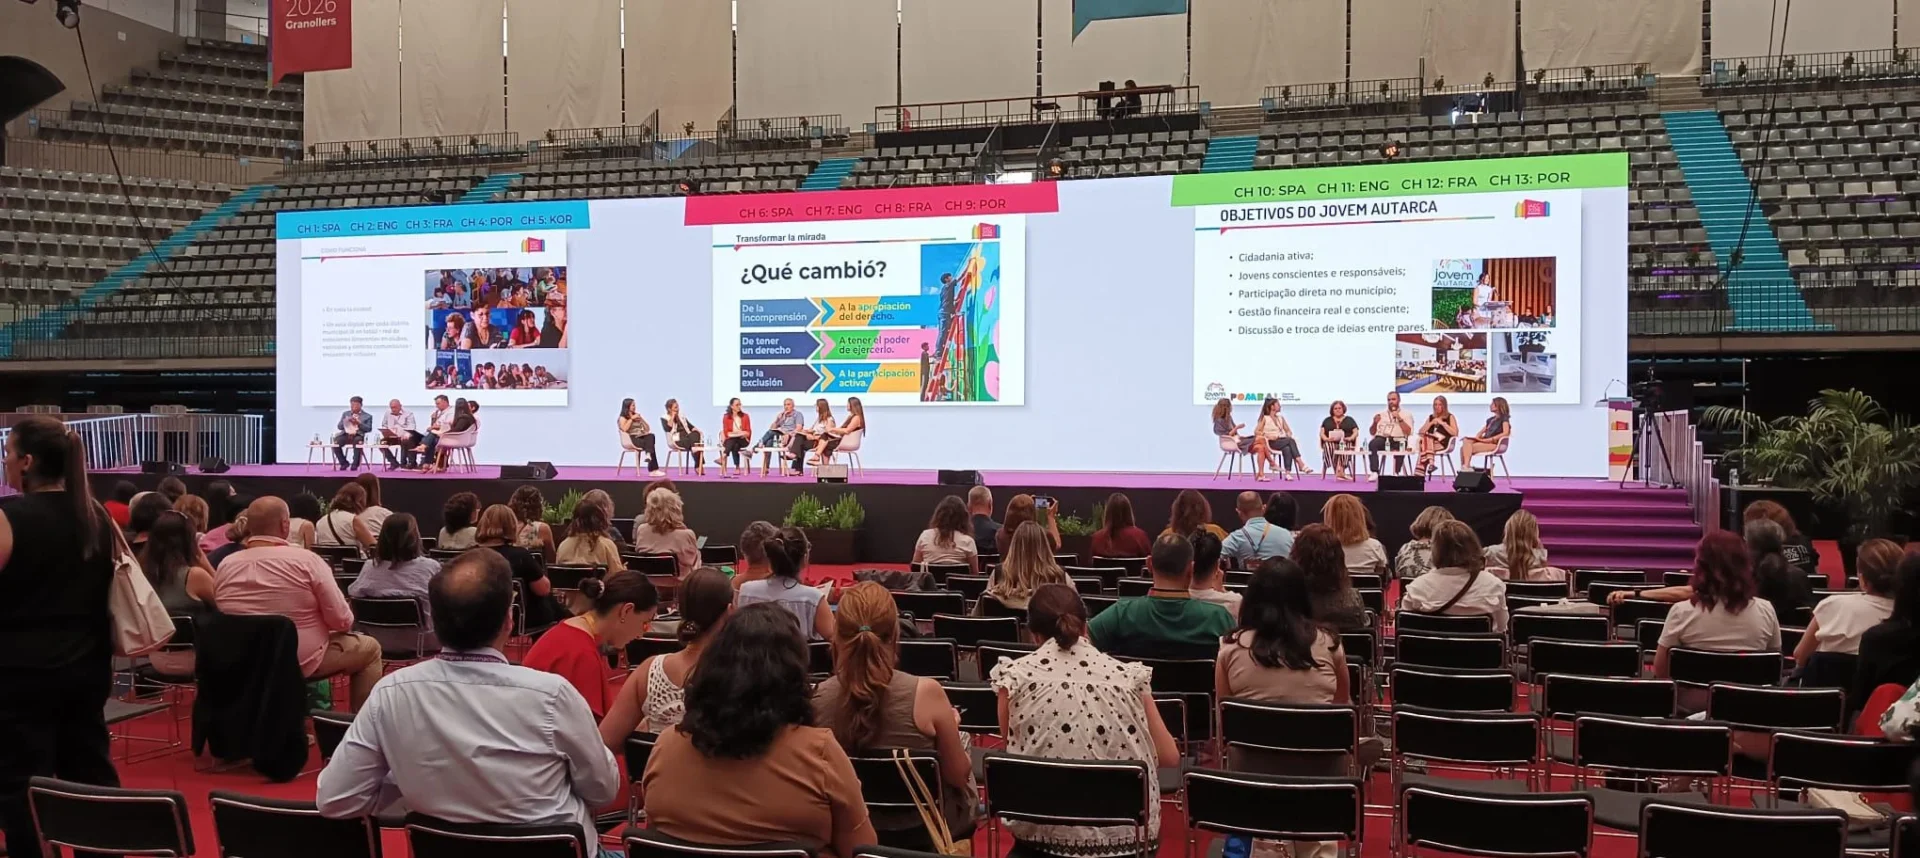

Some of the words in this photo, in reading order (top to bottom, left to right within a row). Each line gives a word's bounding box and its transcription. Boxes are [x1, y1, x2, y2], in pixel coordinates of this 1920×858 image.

[286, 0, 337, 17] 2026
[285, 17, 337, 30] Granollers
[1234, 186, 1254, 198] CH
[1257, 186, 1275, 197] 10:
[1278, 185, 1306, 196] SPA
[1317, 183, 1337, 194] CH
[1341, 182, 1354, 193] 11:
[1359, 181, 1390, 192] ENG
[1401, 178, 1422, 190] CH
[1427, 178, 1443, 189] 12:
[1448, 176, 1477, 188] FRA
[1489, 174, 1511, 186] CH
[1515, 174, 1533, 185] 13:
[1537, 172, 1571, 184] POR
[740, 209, 755, 218] CH
[759, 208, 768, 218] 6:
[771, 207, 794, 217] SPA
[806, 206, 822, 216] CH
[825, 206, 834, 215] 7:
[837, 204, 862, 215] ENG
[875, 203, 891, 213] CH
[895, 203, 905, 213] 8:
[908, 202, 932, 212] FRA
[945, 201, 962, 210] CH
[965, 200, 975, 209] 9:
[979, 199, 1006, 209] POR
[1220, 206, 1294, 222] OBJETIVOS
[1298, 206, 1316, 218] DO
[1319, 204, 1367, 218] JOVEM
[1371, 200, 1438, 215] AUTARCA
[297, 225, 311, 233] CH
[322, 224, 340, 232] SPA
[350, 222, 364, 231] CH
[367, 222, 374, 230] 2:
[377, 221, 398, 230] ENG
[406, 220, 420, 229] CH
[423, 220, 430, 228] 3:
[433, 219, 453, 228] FRA
[461, 218, 475, 227] CH
[478, 218, 487, 226] 4:
[490, 217, 513, 226] POR
[521, 216, 535, 225] CH
[538, 216, 547, 224] 5:
[550, 214, 573, 224] KOR
[736, 234, 786, 243] Transformar
[797, 233, 826, 241] mirada
[1238, 252, 1285, 262] Cidadania
[1287, 251, 1314, 261] ativa;
[740, 262, 793, 285] ¿Qué
[799, 261, 887, 280] cambió?
[1238, 272, 1270, 281] Jovens
[1272, 270, 1328, 279] conscientes
[1330, 270, 1337, 278] e
[1340, 267, 1406, 278] responsáveis;
[1434, 268, 1474, 282] jovem
[1238, 288, 1296, 299] Participação
[1298, 288, 1327, 297] direta
[1345, 286, 1396, 297] município;
[756, 304, 764, 312] la
[839, 303, 846, 311] A
[848, 303, 856, 311] la
[858, 302, 911, 312] apropiación
[1238, 306, 1271, 316] Gestão
[1273, 306, 1321, 316] financeira
[1324, 306, 1342, 315] real
[1353, 305, 1409, 315] consciente;
[742, 312, 807, 323] incomprensión
[839, 313, 853, 321] del
[855, 312, 895, 321] derecho.
[1238, 325, 1284, 335] Discussão
[1286, 326, 1292, 334] e
[1295, 325, 1319, 334] troca
[1322, 324, 1335, 333] de
[1337, 324, 1365, 333] ideias
[1368, 324, 1395, 332] entre
[1398, 324, 1428, 333] pares.
[742, 337, 754, 345] De
[839, 336, 846, 344] A
[873, 336, 882, 344] el
[884, 335, 910, 346] poder
[755, 346, 791, 354] derecho
[839, 345, 851, 354] de
[852, 345, 895, 356] ejercerlo.
[742, 369, 754, 377] De
[756, 369, 764, 377] la
[839, 369, 846, 378] A
[847, 369, 856, 377] la
[857, 368, 915, 379] participación
[742, 378, 783, 387] exclusión
[839, 379, 868, 387] activa.
